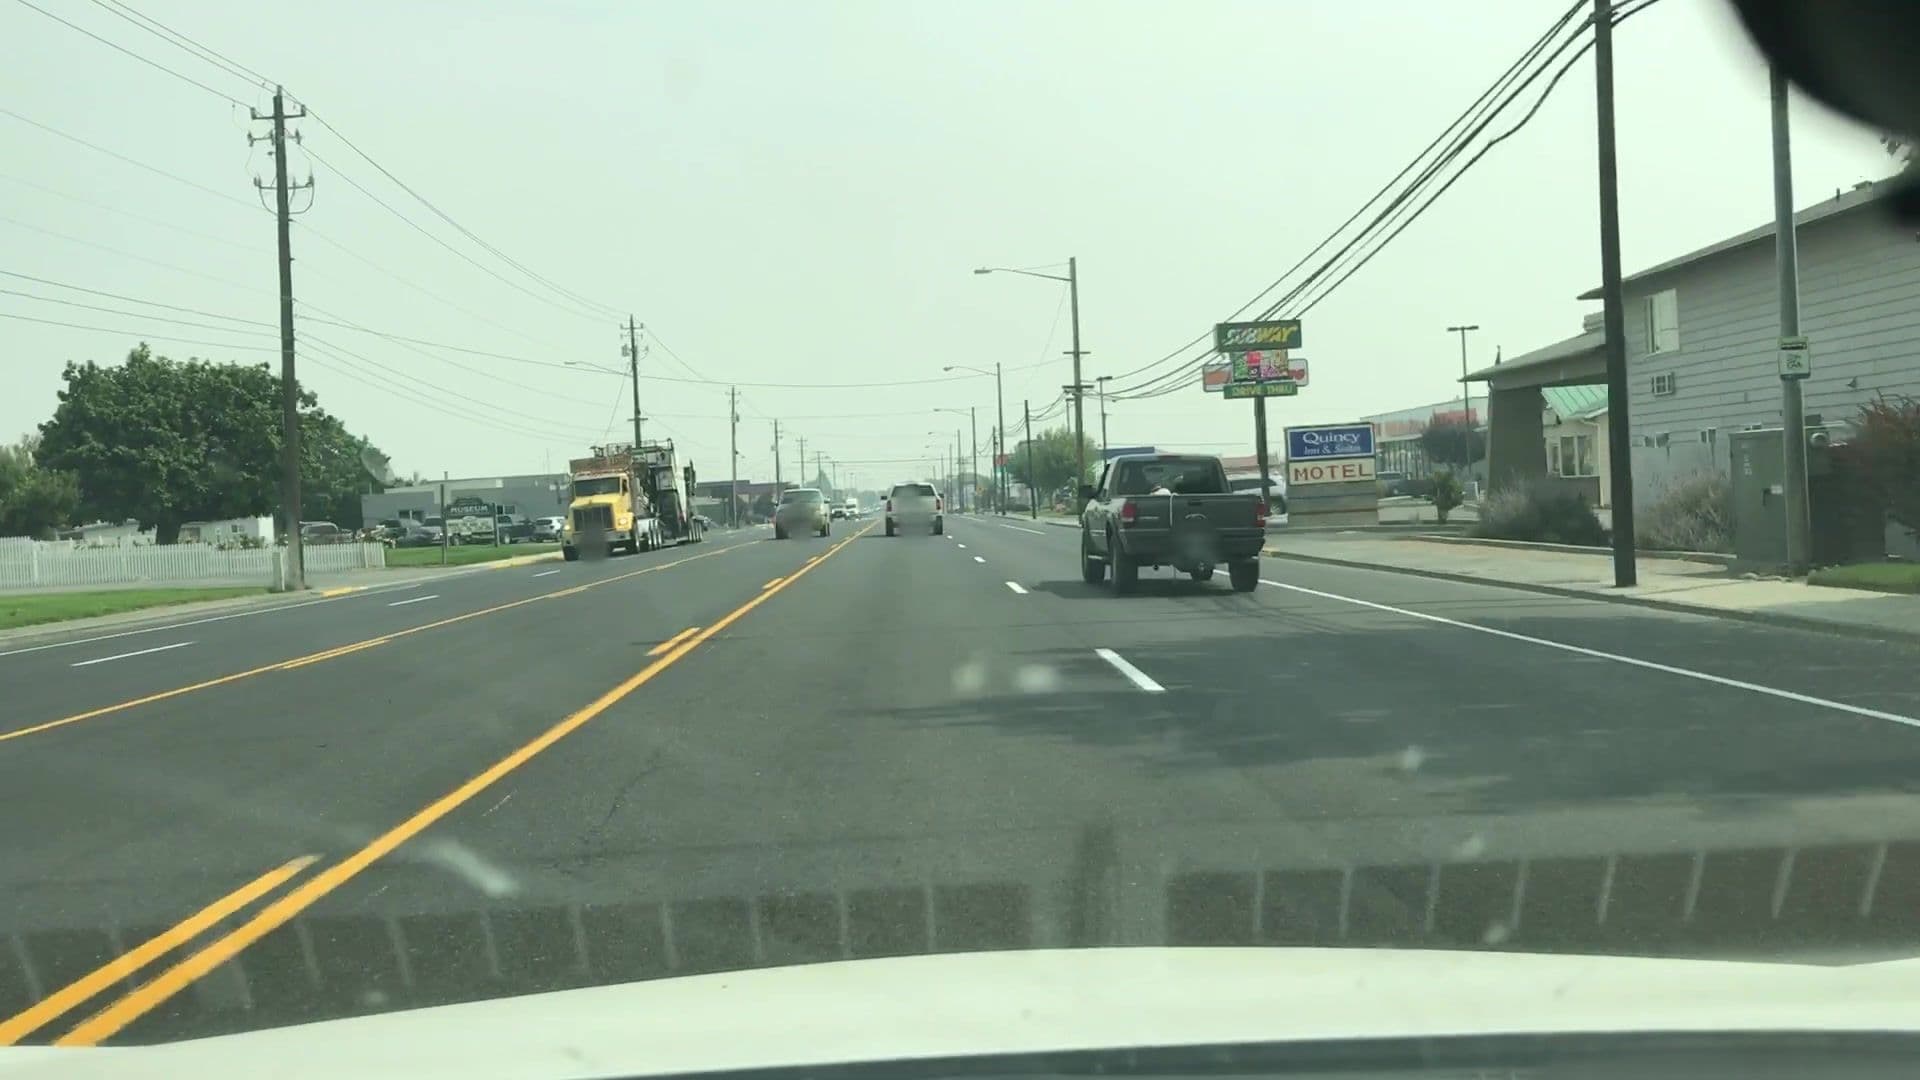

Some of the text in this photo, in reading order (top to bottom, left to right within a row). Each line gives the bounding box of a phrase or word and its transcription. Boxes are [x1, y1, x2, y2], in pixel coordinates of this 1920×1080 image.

[1224, 325, 1298, 346] SUBWAY
[1302, 432, 1360, 446] Quincy
[1293, 463, 1373, 482] MOTEL
